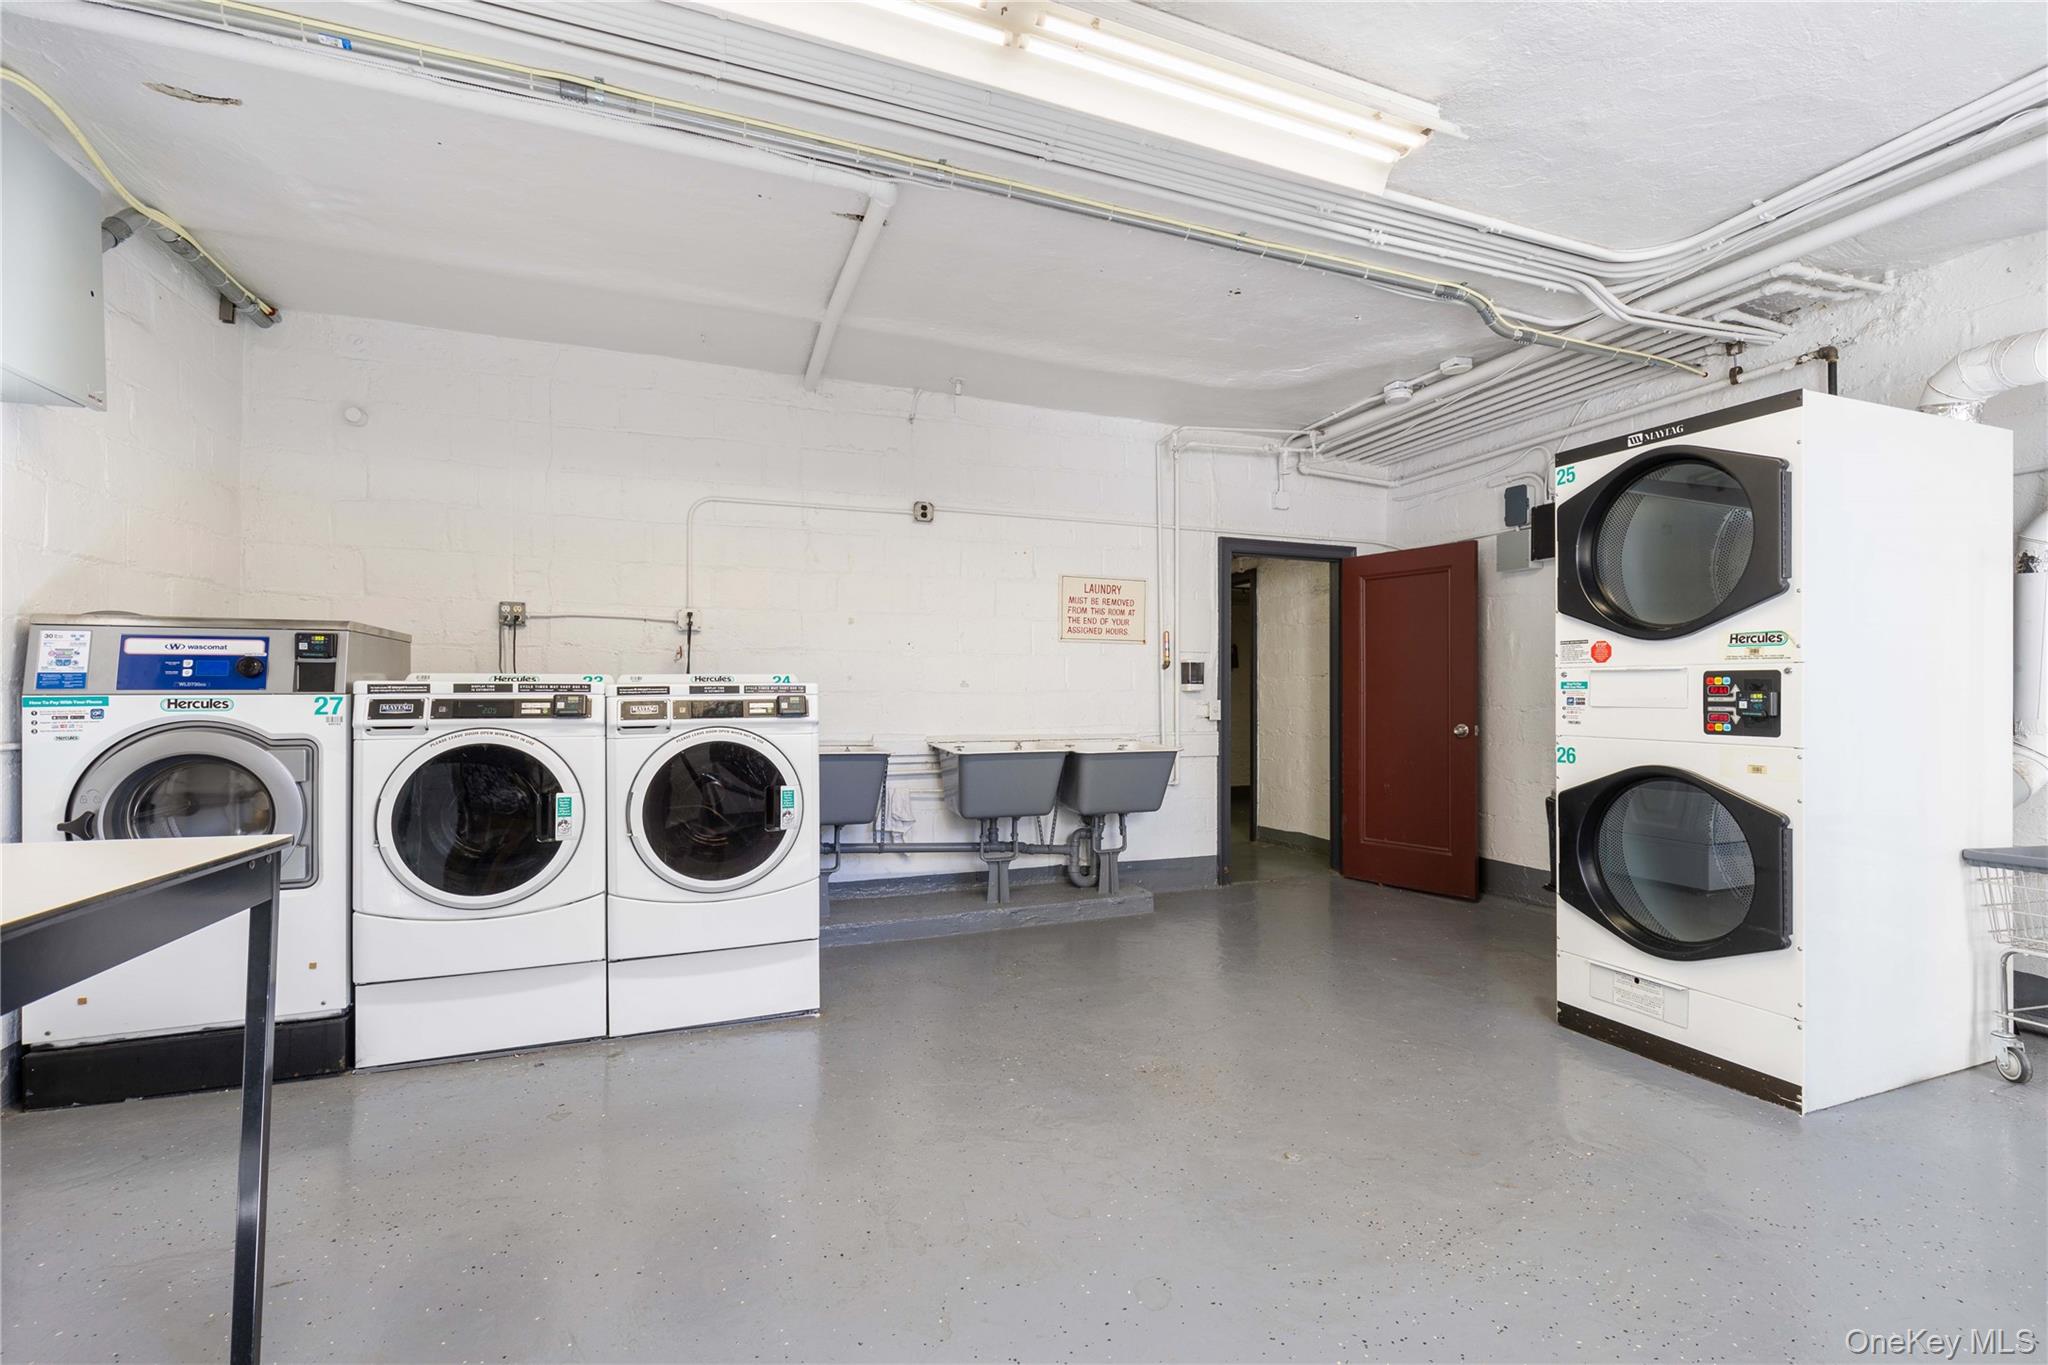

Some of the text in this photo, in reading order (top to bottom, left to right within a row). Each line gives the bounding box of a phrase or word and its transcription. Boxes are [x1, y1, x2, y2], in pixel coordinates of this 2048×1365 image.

[1643, 424, 1684, 442] MAYTAG
[1556, 465, 1576, 486] 25
[1084, 583, 1122, 595] LAUNDRY
[1068, 596, 1135, 608] MUST BE REMOVED
[1067, 606, 1136, 617] FROM THIS ROOM AT
[1067, 616, 1130, 626] THE END OF YOUR
[1067, 626, 1128, 636] ASSIGNED HOURS
[1729, 632, 1783, 645] Hercules
[187, 643, 228, 651] wascomat
[772, 675, 790, 684] 24
[167, 698, 229, 710] Hercules
[314, 696, 344, 715] 27
[381, 704, 412, 712] MAYTAG
[430, 738, 447, 747] PLEASE
[676, 734, 691, 743] PLEASE
[1556, 746, 1577, 764] 26
